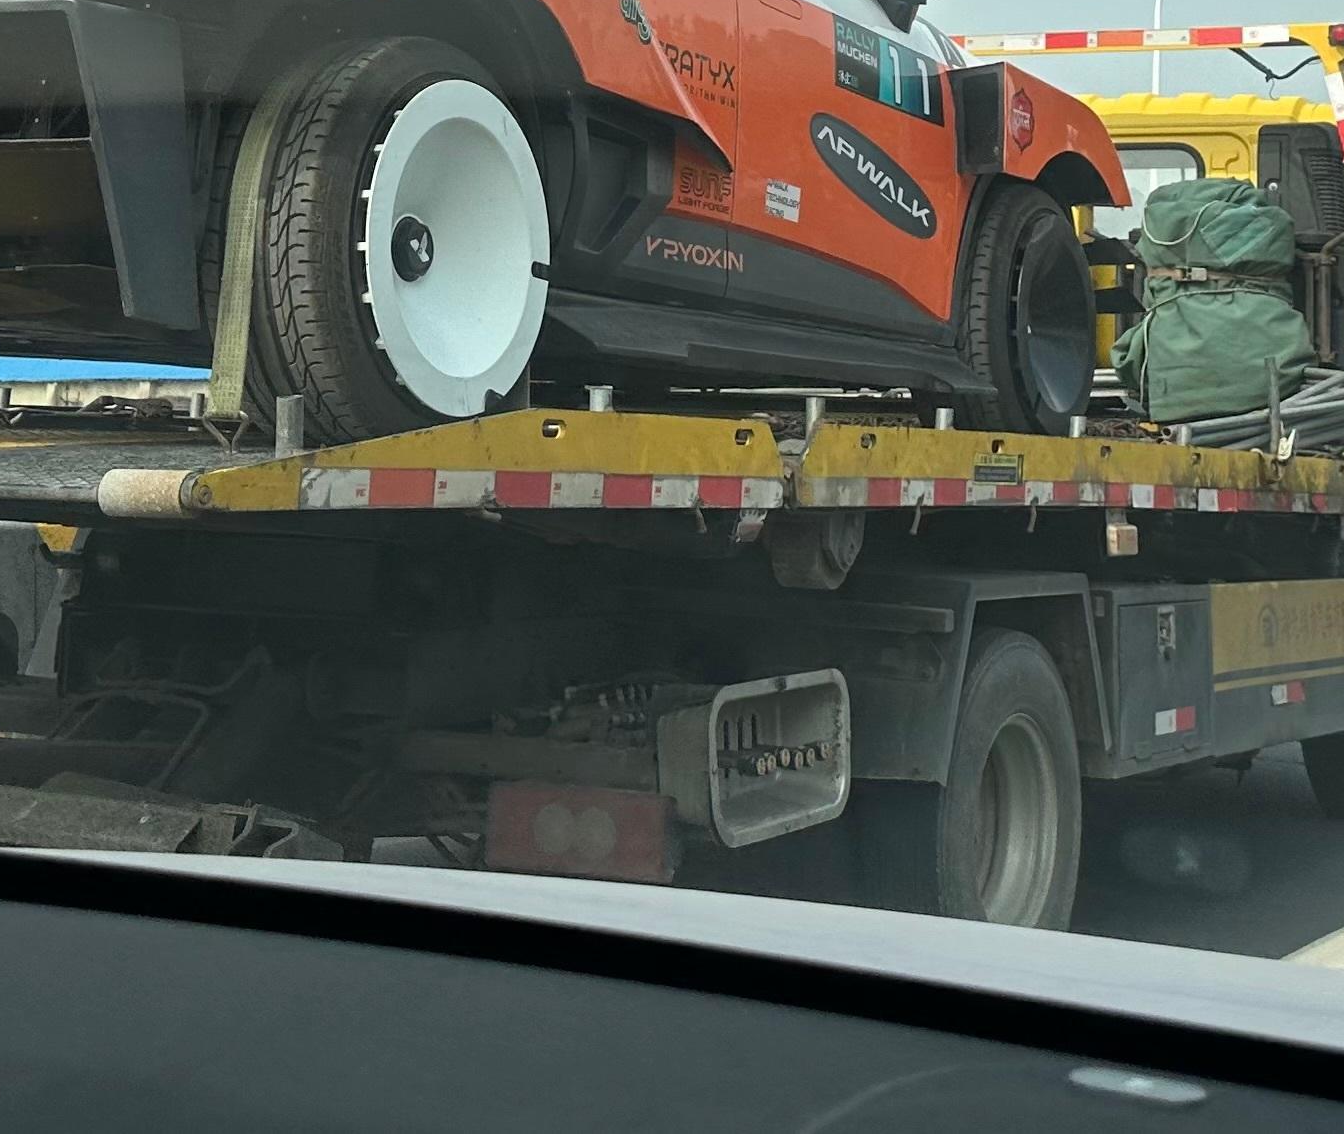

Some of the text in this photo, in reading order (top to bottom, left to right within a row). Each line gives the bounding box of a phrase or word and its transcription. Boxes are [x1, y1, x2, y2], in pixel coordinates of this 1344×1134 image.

[836, 22, 875, 52] RALLY
[837, 40, 878, 69] MUCHEN
[888, 45, 931, 116] 11
